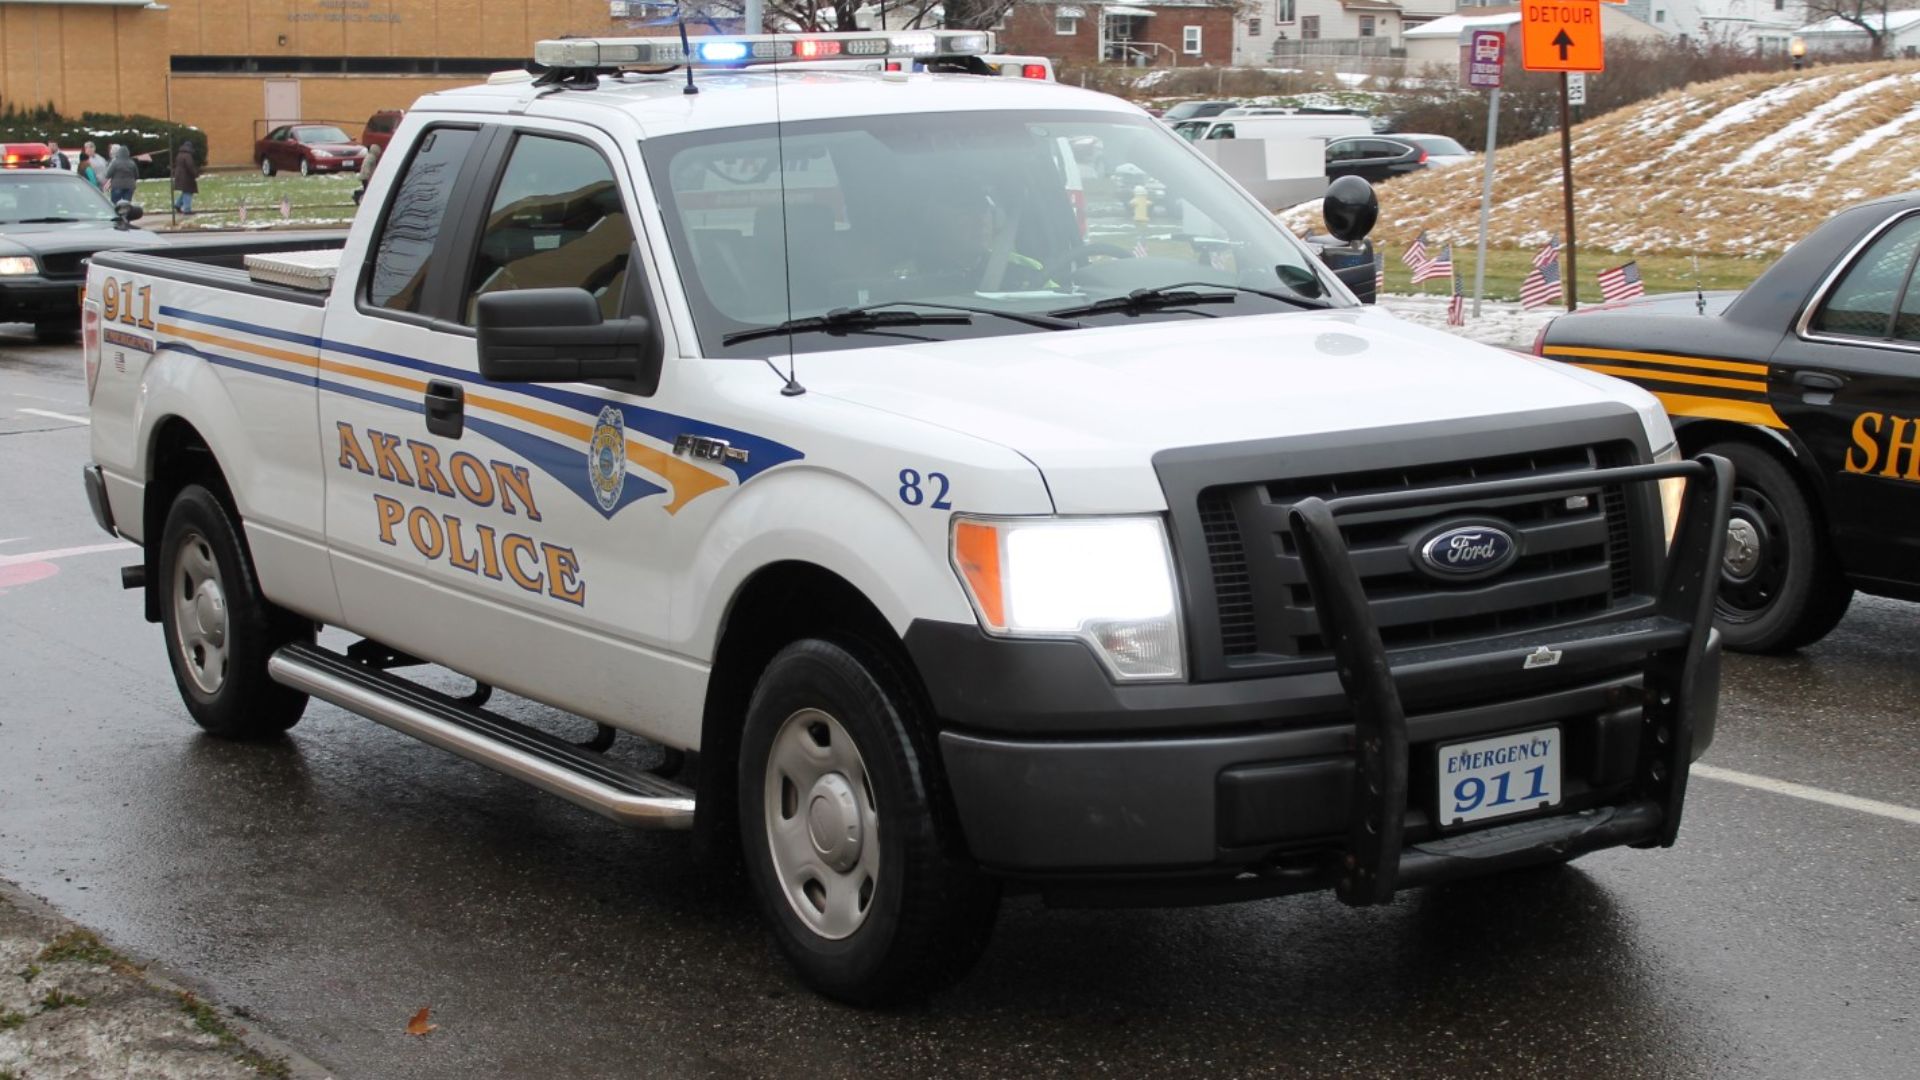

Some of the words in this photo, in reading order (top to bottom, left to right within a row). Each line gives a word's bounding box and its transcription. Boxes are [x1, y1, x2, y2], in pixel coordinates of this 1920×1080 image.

[1529, 5, 1593, 24] DETOUR
[103, 276, 155, 331] 911
[337, 421, 542, 522] AKRON
[899, 468, 952, 511] 82
[374, 494, 585, 607] POLICE
[1447, 533, 1495, 562] Ford
[1447, 739, 1551, 774] EMERGENCY
[1453, 764, 1550, 813] 911
